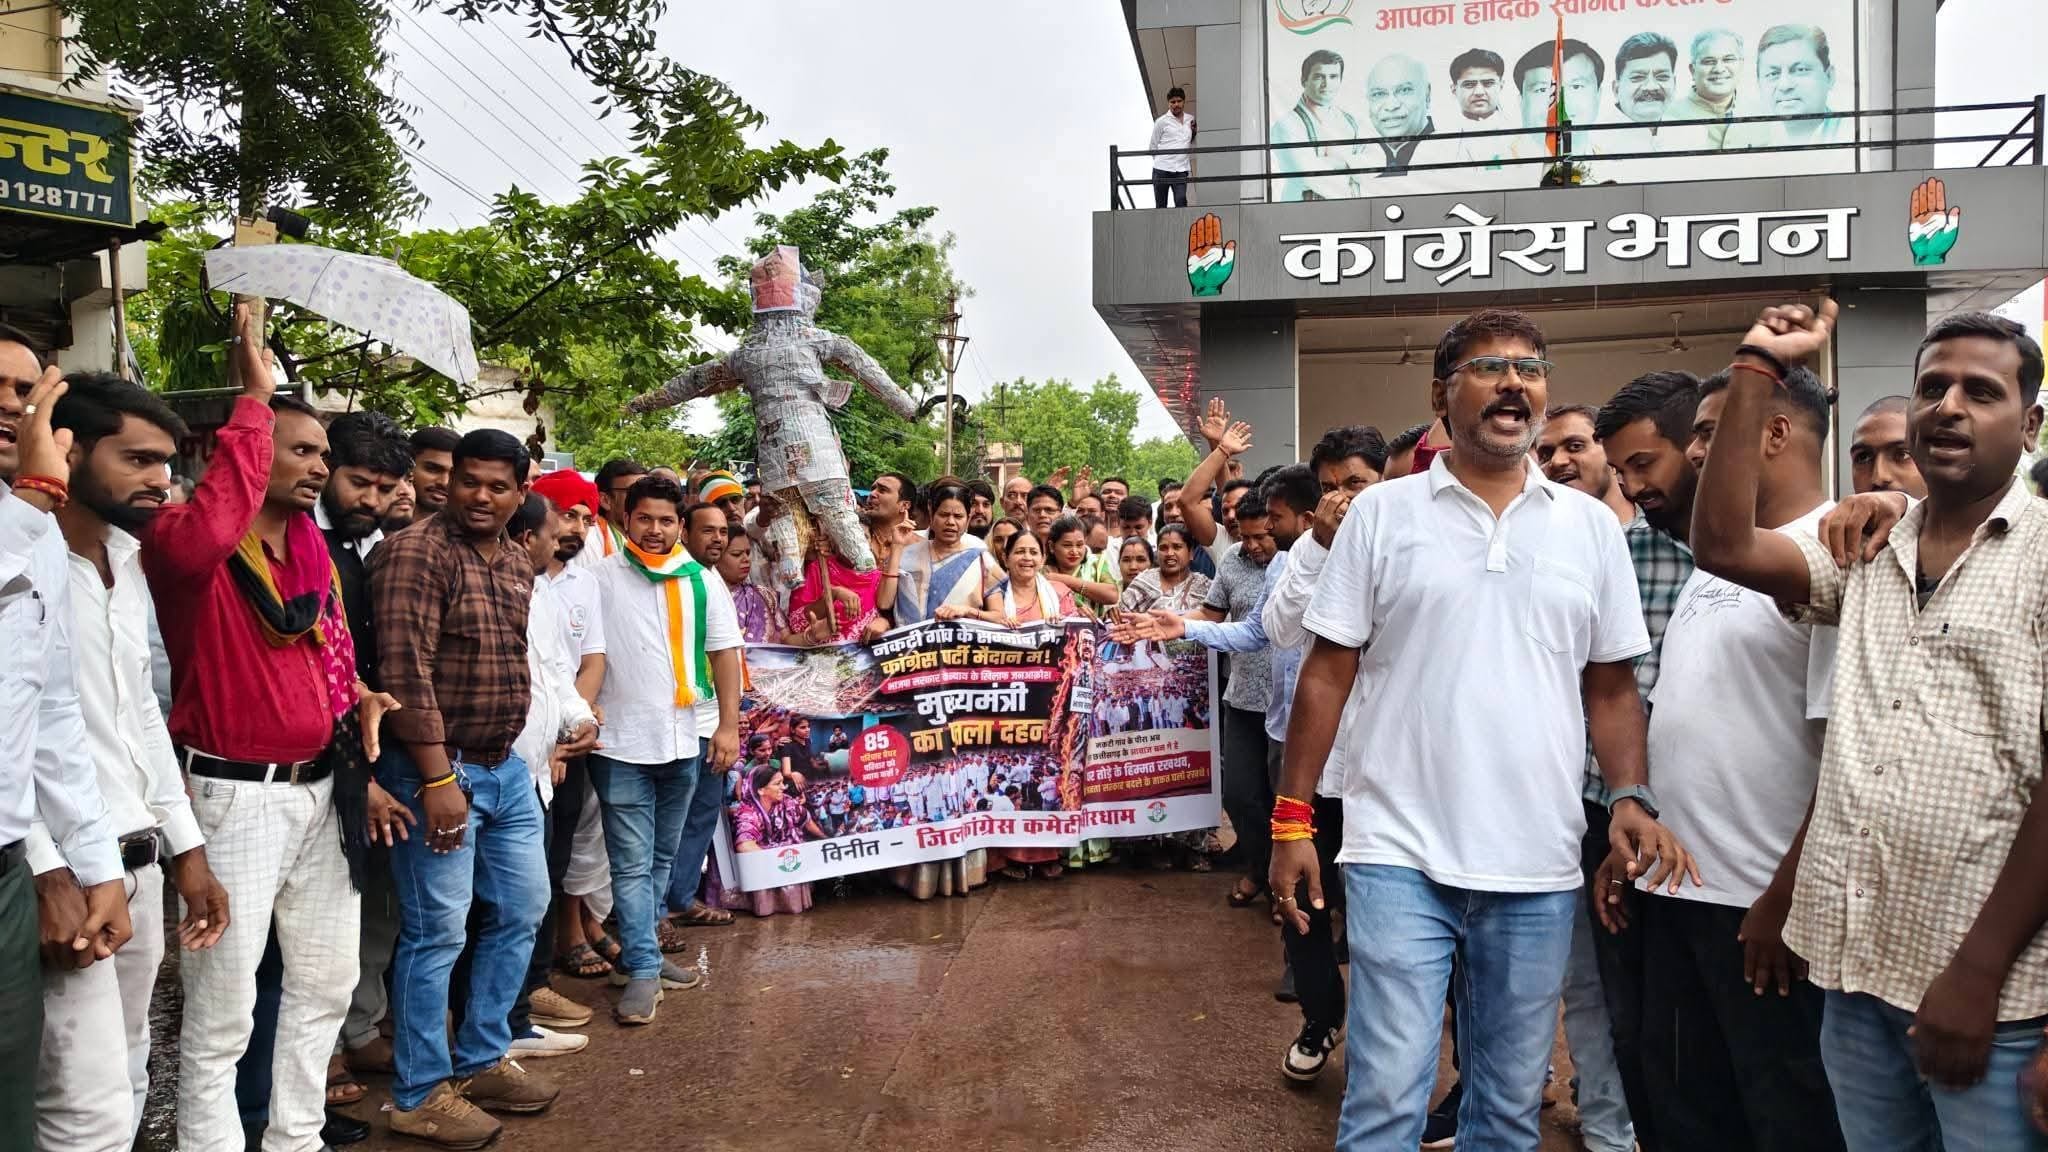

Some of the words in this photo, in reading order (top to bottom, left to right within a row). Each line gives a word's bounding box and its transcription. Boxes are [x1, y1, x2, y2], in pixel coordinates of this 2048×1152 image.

[1375, 4, 1456, 31] आपका
[1281, 202, 1596, 285] कांग्रेस
[1607, 204, 1858, 269] भवन
[956, 625, 974, 643] के
[864, 730, 889, 752] 85
[911, 728, 944, 754] का
[821, 838, 881, 863] विनीत
